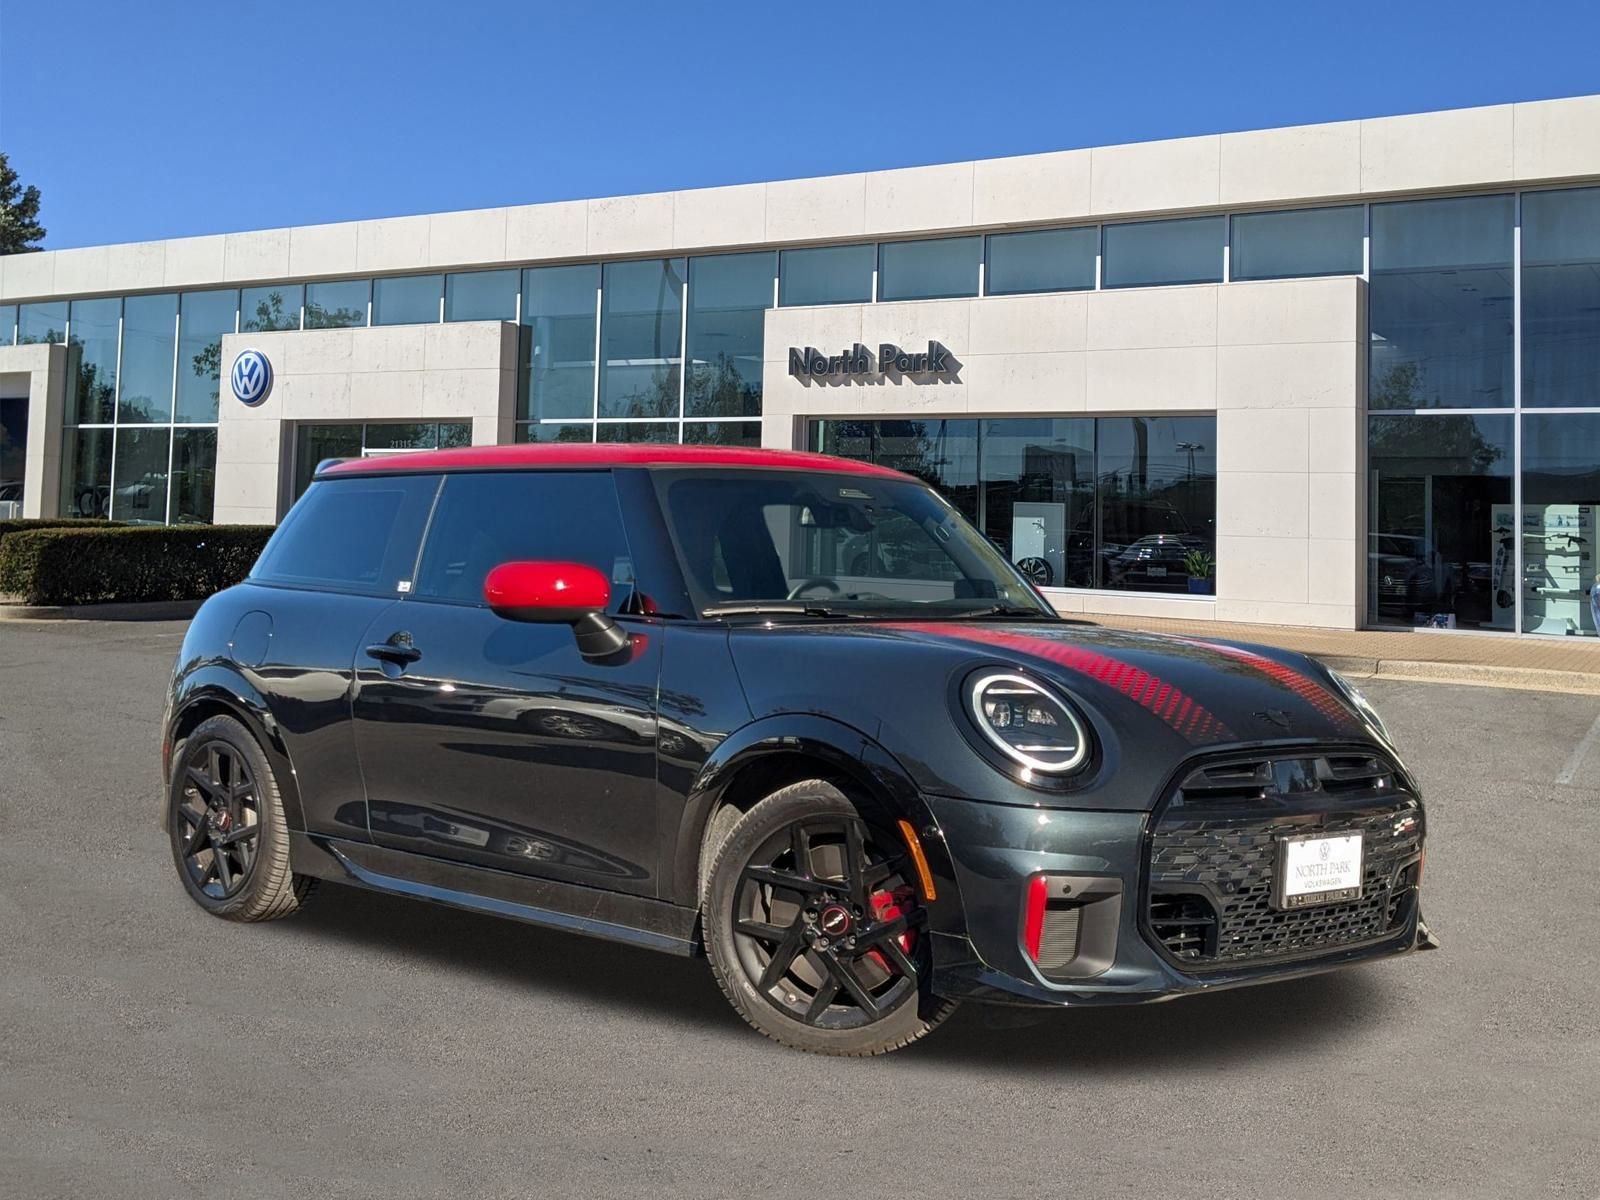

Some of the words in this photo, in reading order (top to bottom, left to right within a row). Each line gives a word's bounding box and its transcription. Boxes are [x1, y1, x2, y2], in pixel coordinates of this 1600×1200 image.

[233, 353, 265, 399] VW
[788, 343, 871, 376] North
[878, 340, 946, 373] Park
[1296, 863, 1328, 879] NORTH
[1329, 860, 1352, 875] PARK
